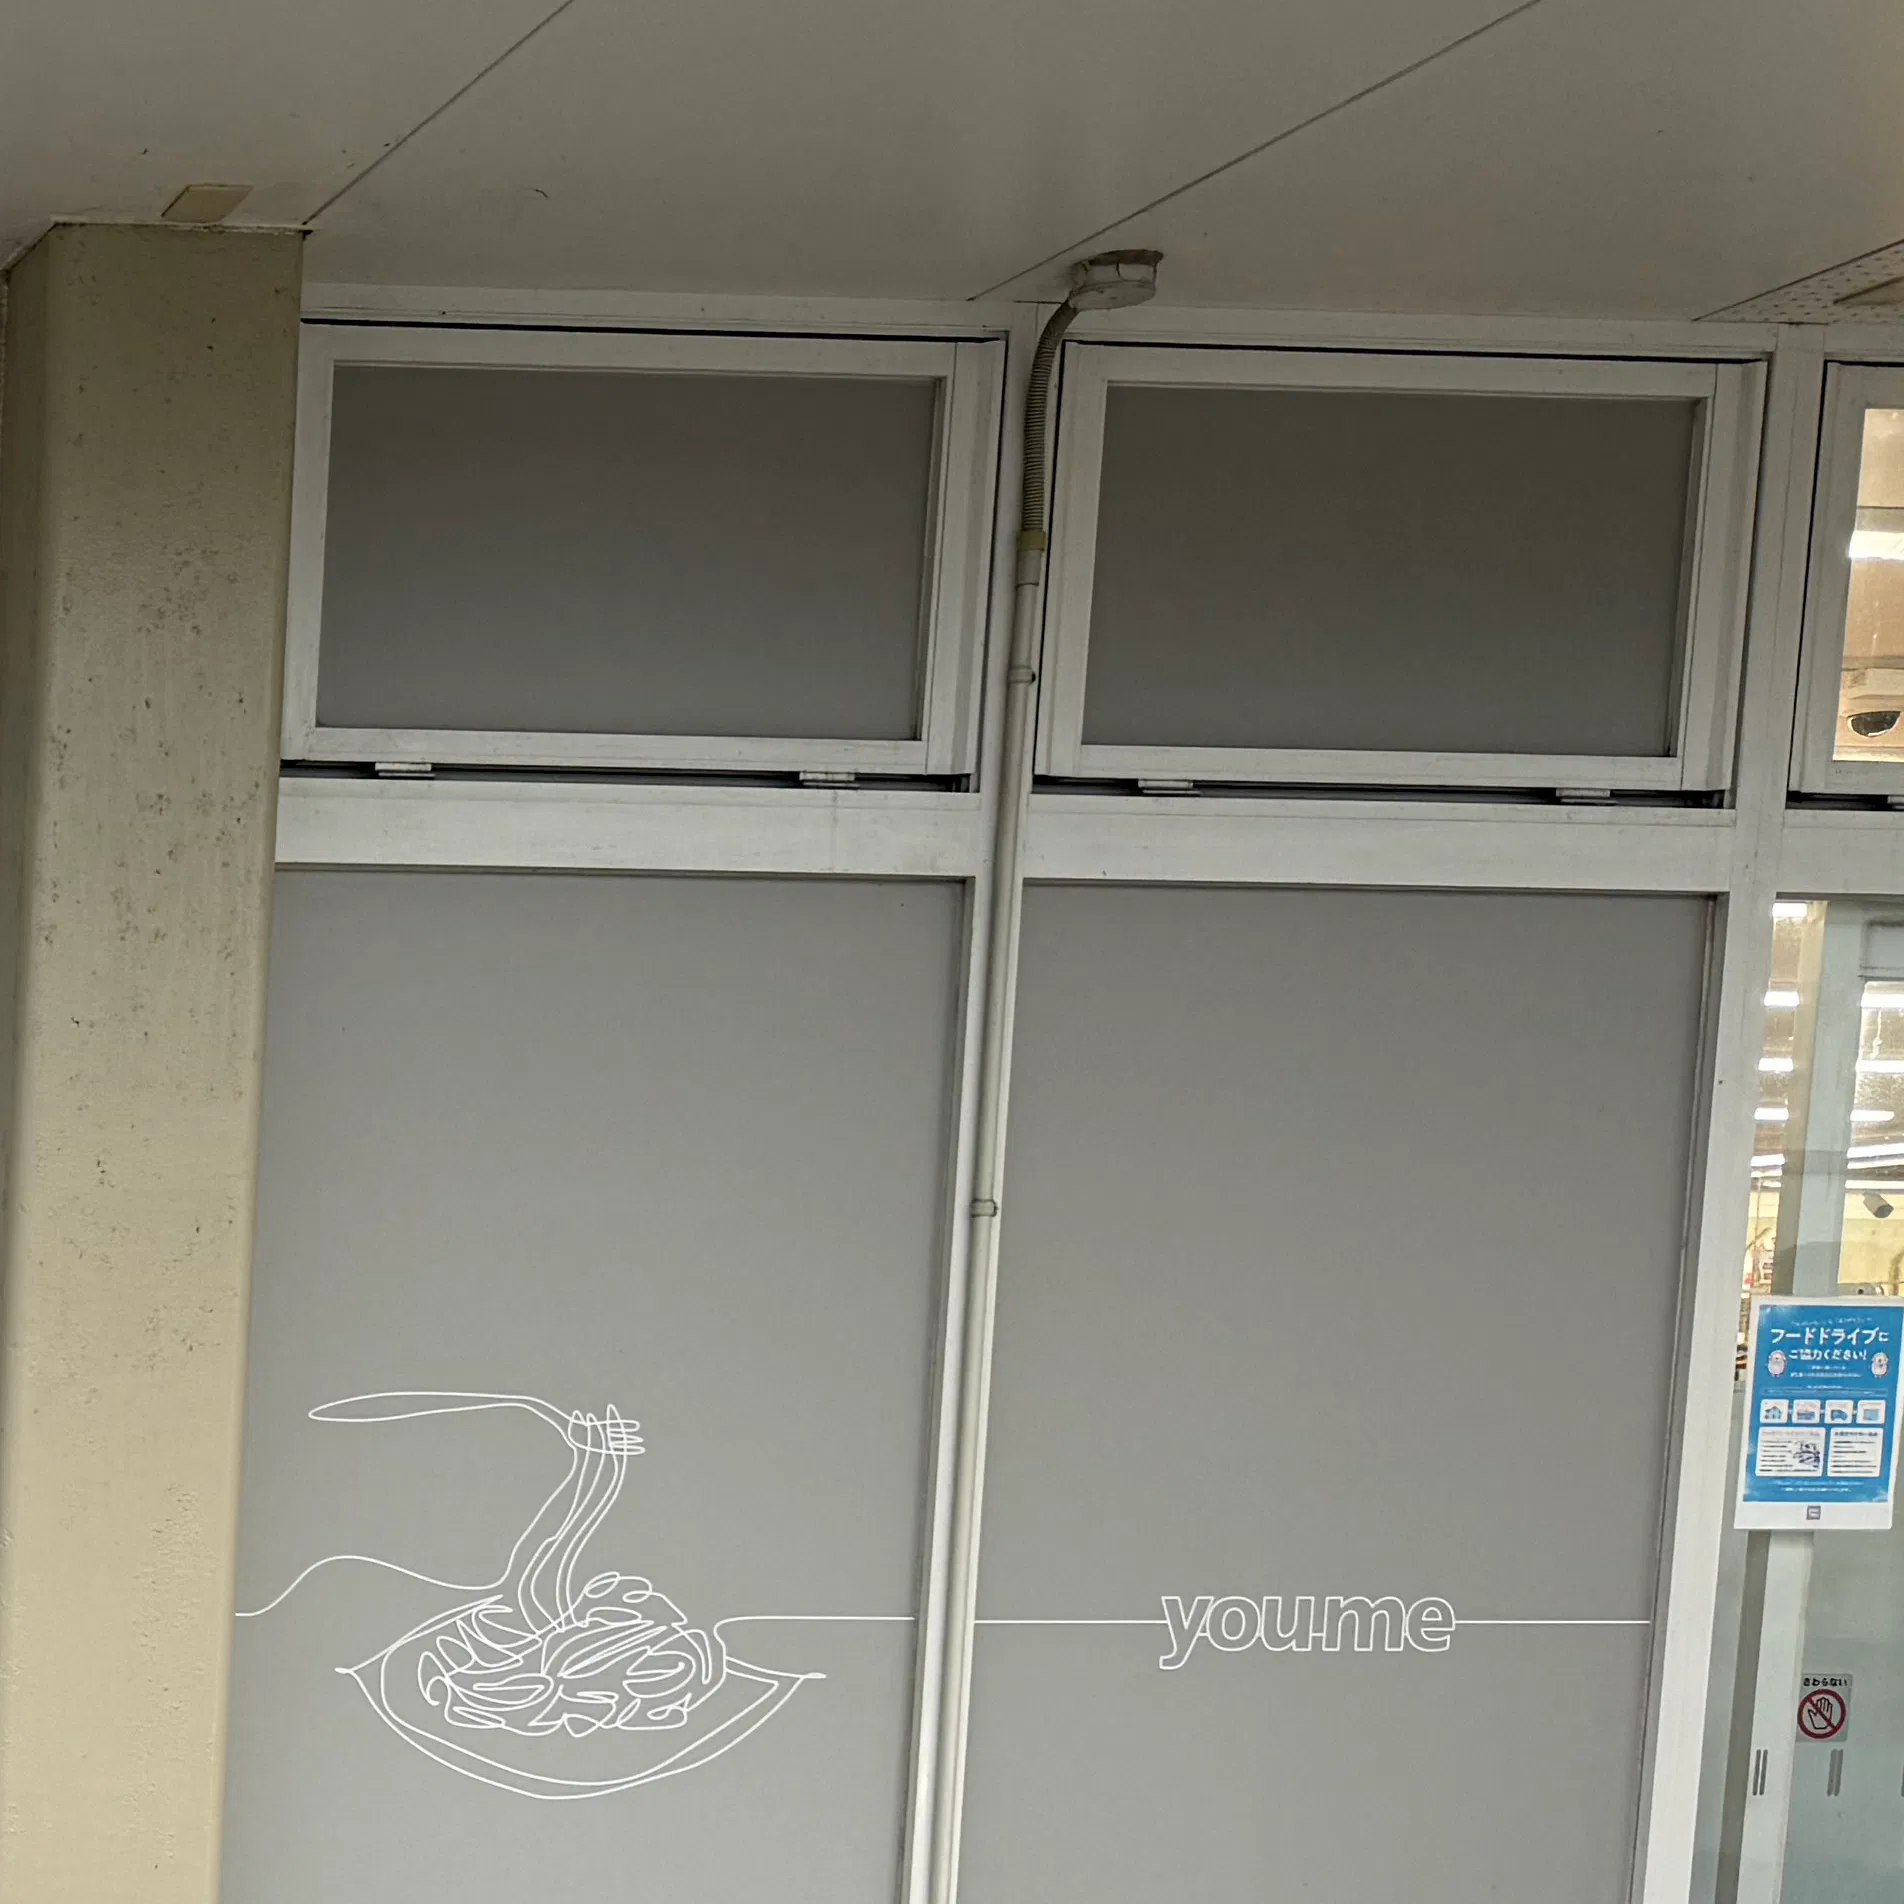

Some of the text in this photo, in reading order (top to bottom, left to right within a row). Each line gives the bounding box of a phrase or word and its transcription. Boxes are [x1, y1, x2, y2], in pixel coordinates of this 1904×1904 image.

[1770, 1327, 1890, 1346] フードドライブに
[1158, 1595, 1456, 1670] youme
[1803, 1677, 1848, 1687] さわらない
